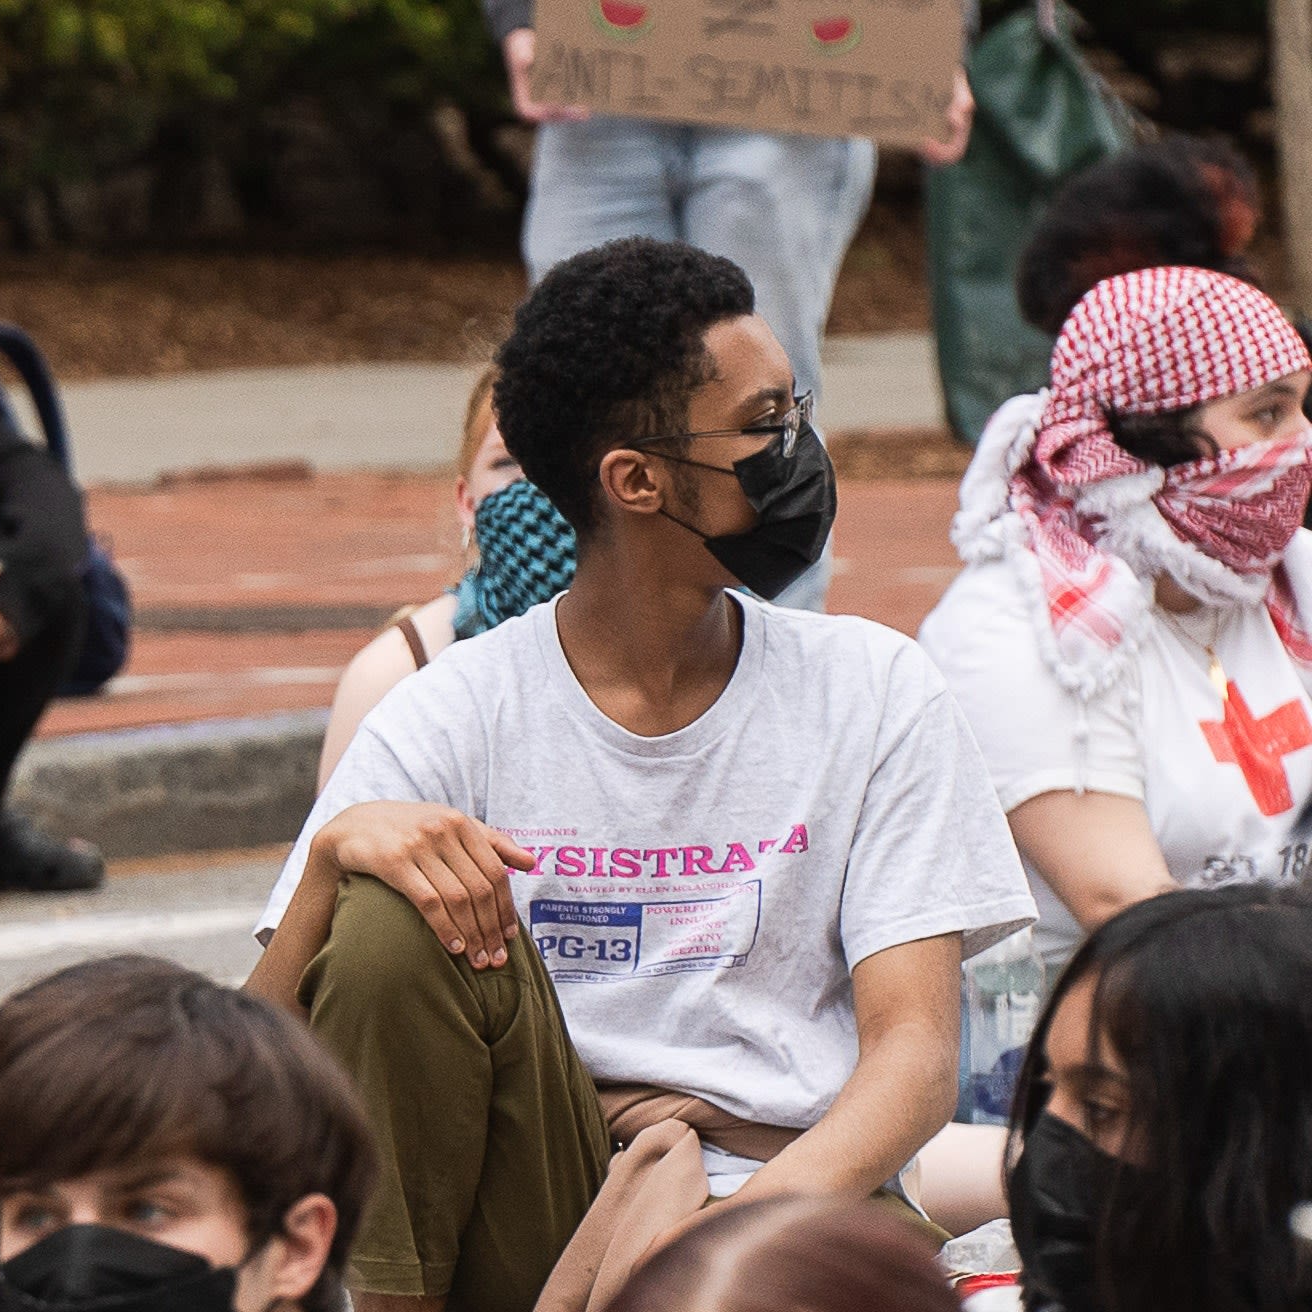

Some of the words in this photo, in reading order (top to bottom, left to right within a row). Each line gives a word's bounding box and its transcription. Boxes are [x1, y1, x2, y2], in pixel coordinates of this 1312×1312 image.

[635, 885, 670, 895] ELLEN
[539, 902, 579, 914] PARENTS
[581, 905, 627, 915] STRONGLY
[559, 913, 609, 924] CAUTIONED
[535, 934, 632, 963] PG-13
